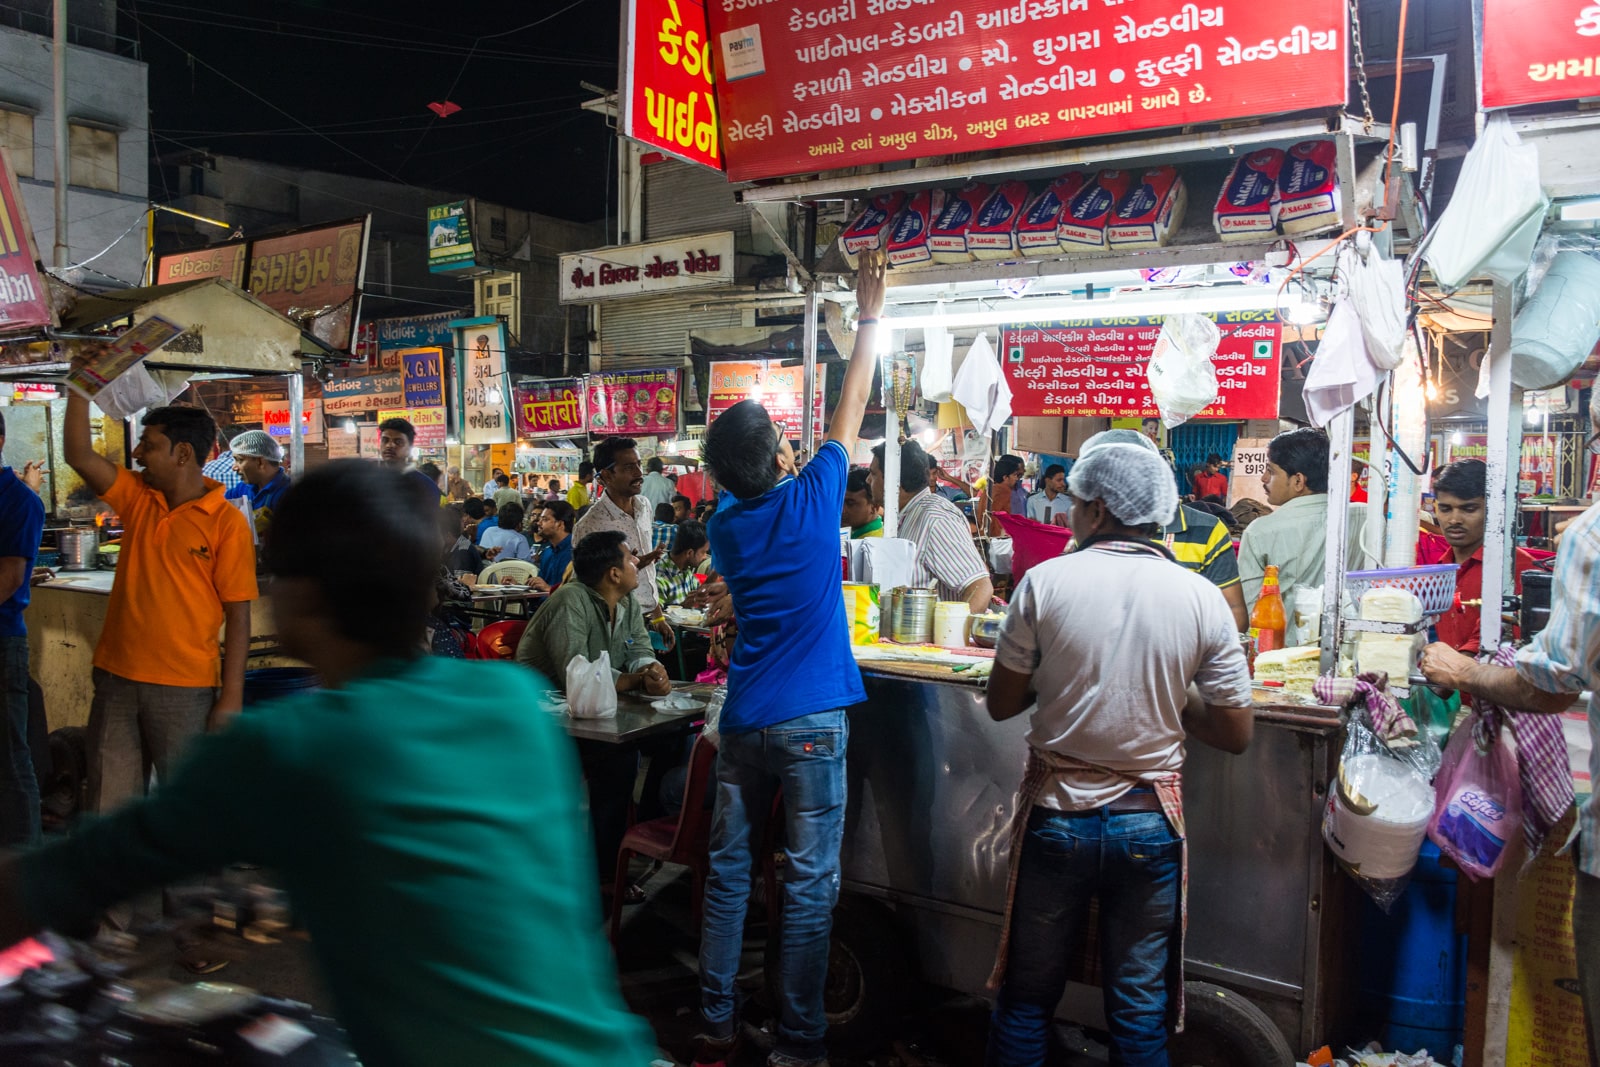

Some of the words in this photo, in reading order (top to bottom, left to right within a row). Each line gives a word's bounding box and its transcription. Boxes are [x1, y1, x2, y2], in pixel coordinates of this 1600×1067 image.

[788, 0, 857, 32] કેડબરી
[795, 10, 965, 63] પાઈનેપલ-કેડબરી
[792, 67, 852, 102] ફરાળી
[862, 53, 948, 88] સેન્ડવીચ
[982, 39, 1018, 67] સ્પે.
[1113, 3, 1224, 44] સેન્ડવીચ
[728, 114, 773, 142] સેલ્ફી
[782, 104, 861, 134] સેન્ડવીચ
[891, 86, 987, 117] મેક્સીકન
[999, 65, 1097, 101] સેન્ડવીચ
[1135, 44, 1203, 87] કુલ્ફી
[1216, 25, 1337, 67] સેન્ડવીચ
[808, 137, 845, 157] અમારે
[850, 133, 873, 152] ત્યાં
[879, 131, 917, 151] અમુલ
[923, 123, 958, 141] ચીઝ,
[966, 118, 1007, 138] અમુલ
[1014, 112, 1050, 129] બટર
[1057, 94, 1133, 122] વાપરવામાં
[1141, 87, 1180, 110] આવે
[1188, 83, 1212, 104] છે.
[1287, 202, 1313, 214] SAGAR
[1233, 219, 1256, 227] SAGAR
[1066, 229, 1087, 239] SAGAR
[1118, 230, 1139, 238] SAGAR
[898, 252, 916, 260] SAGAR
[600, 263, 640, 286] સિલ્વર
[684, 249, 721, 274] પેલેસ
[1009, 331, 1039, 343] કેડબરી
[1087, 329, 1124, 342] સેન્ડવીચ
[1093, 343, 1125, 352] સેન્ડવીચ
[1012, 365, 1047, 379] સેલ્ફી
[1052, 364, 1108, 378] સેન્ડવીચ
[1216, 362, 1267, 377] ન્ડવીચ
[1027, 379, 1080, 390] મેક્સીકન
[1085, 379, 1135, 390] સેન્ડવીચ
[1044, 391, 1087, 405] કેડબરી
[1092, 392, 1122, 405] પીઝા
[523, 389, 579, 428] पंजाबी
[1042, 407, 1061, 415] અમારે
[1078, 408, 1097, 417] અમુલ
[1119, 408, 1139, 417] અમુલ
[1452, 443, 1488, 457] Bomba
[1237, 452, 1267, 463] રજવા
